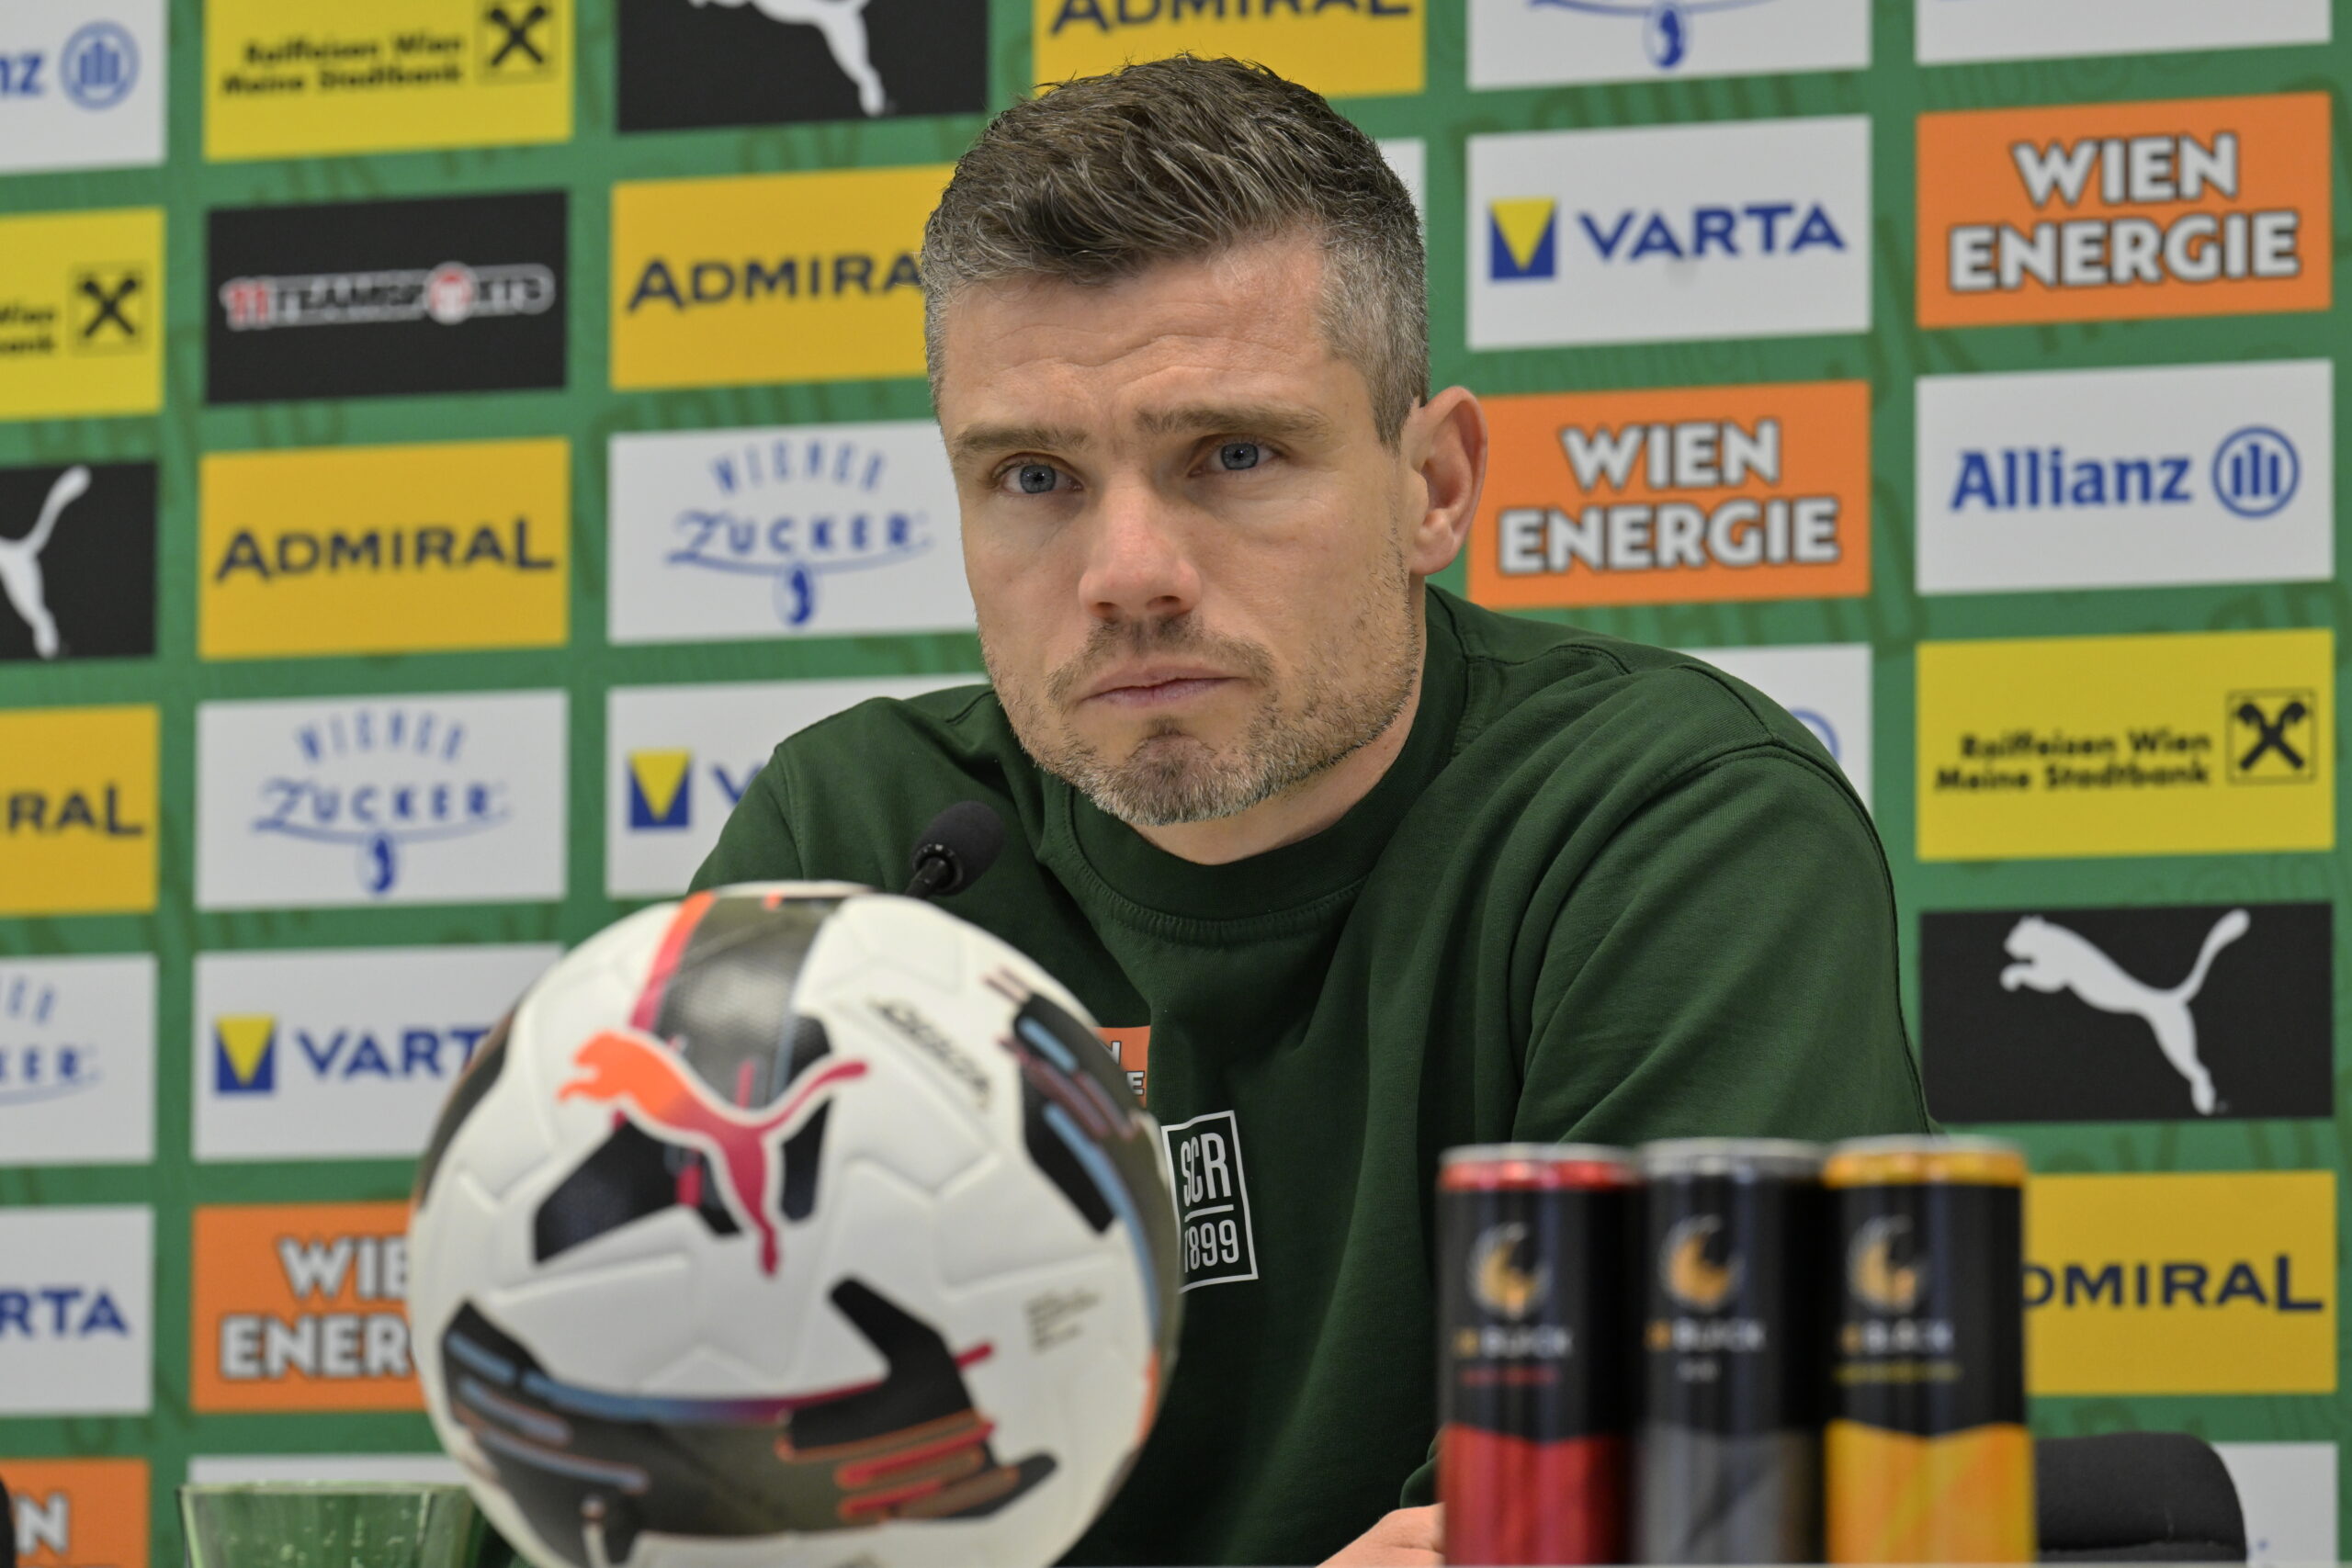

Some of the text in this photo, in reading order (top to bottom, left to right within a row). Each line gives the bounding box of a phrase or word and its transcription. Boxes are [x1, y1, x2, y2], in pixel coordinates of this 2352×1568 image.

[2010, 130, 2239, 209] WIEN
[1577, 201, 1847, 265] VARTA
[1946, 209, 2302, 294] ENERGIE
[1558, 416, 1781, 494] WIEN
[1951, 446, 2192, 513] Allianz
[213, 514, 558, 584] ADMIRAL
[1497, 494, 1841, 578] ENERGIE
[8, 784, 144, 837] RAL
[1181, 1133, 1231, 1207] SCR
[1183, 1219, 1240, 1273] 1899
